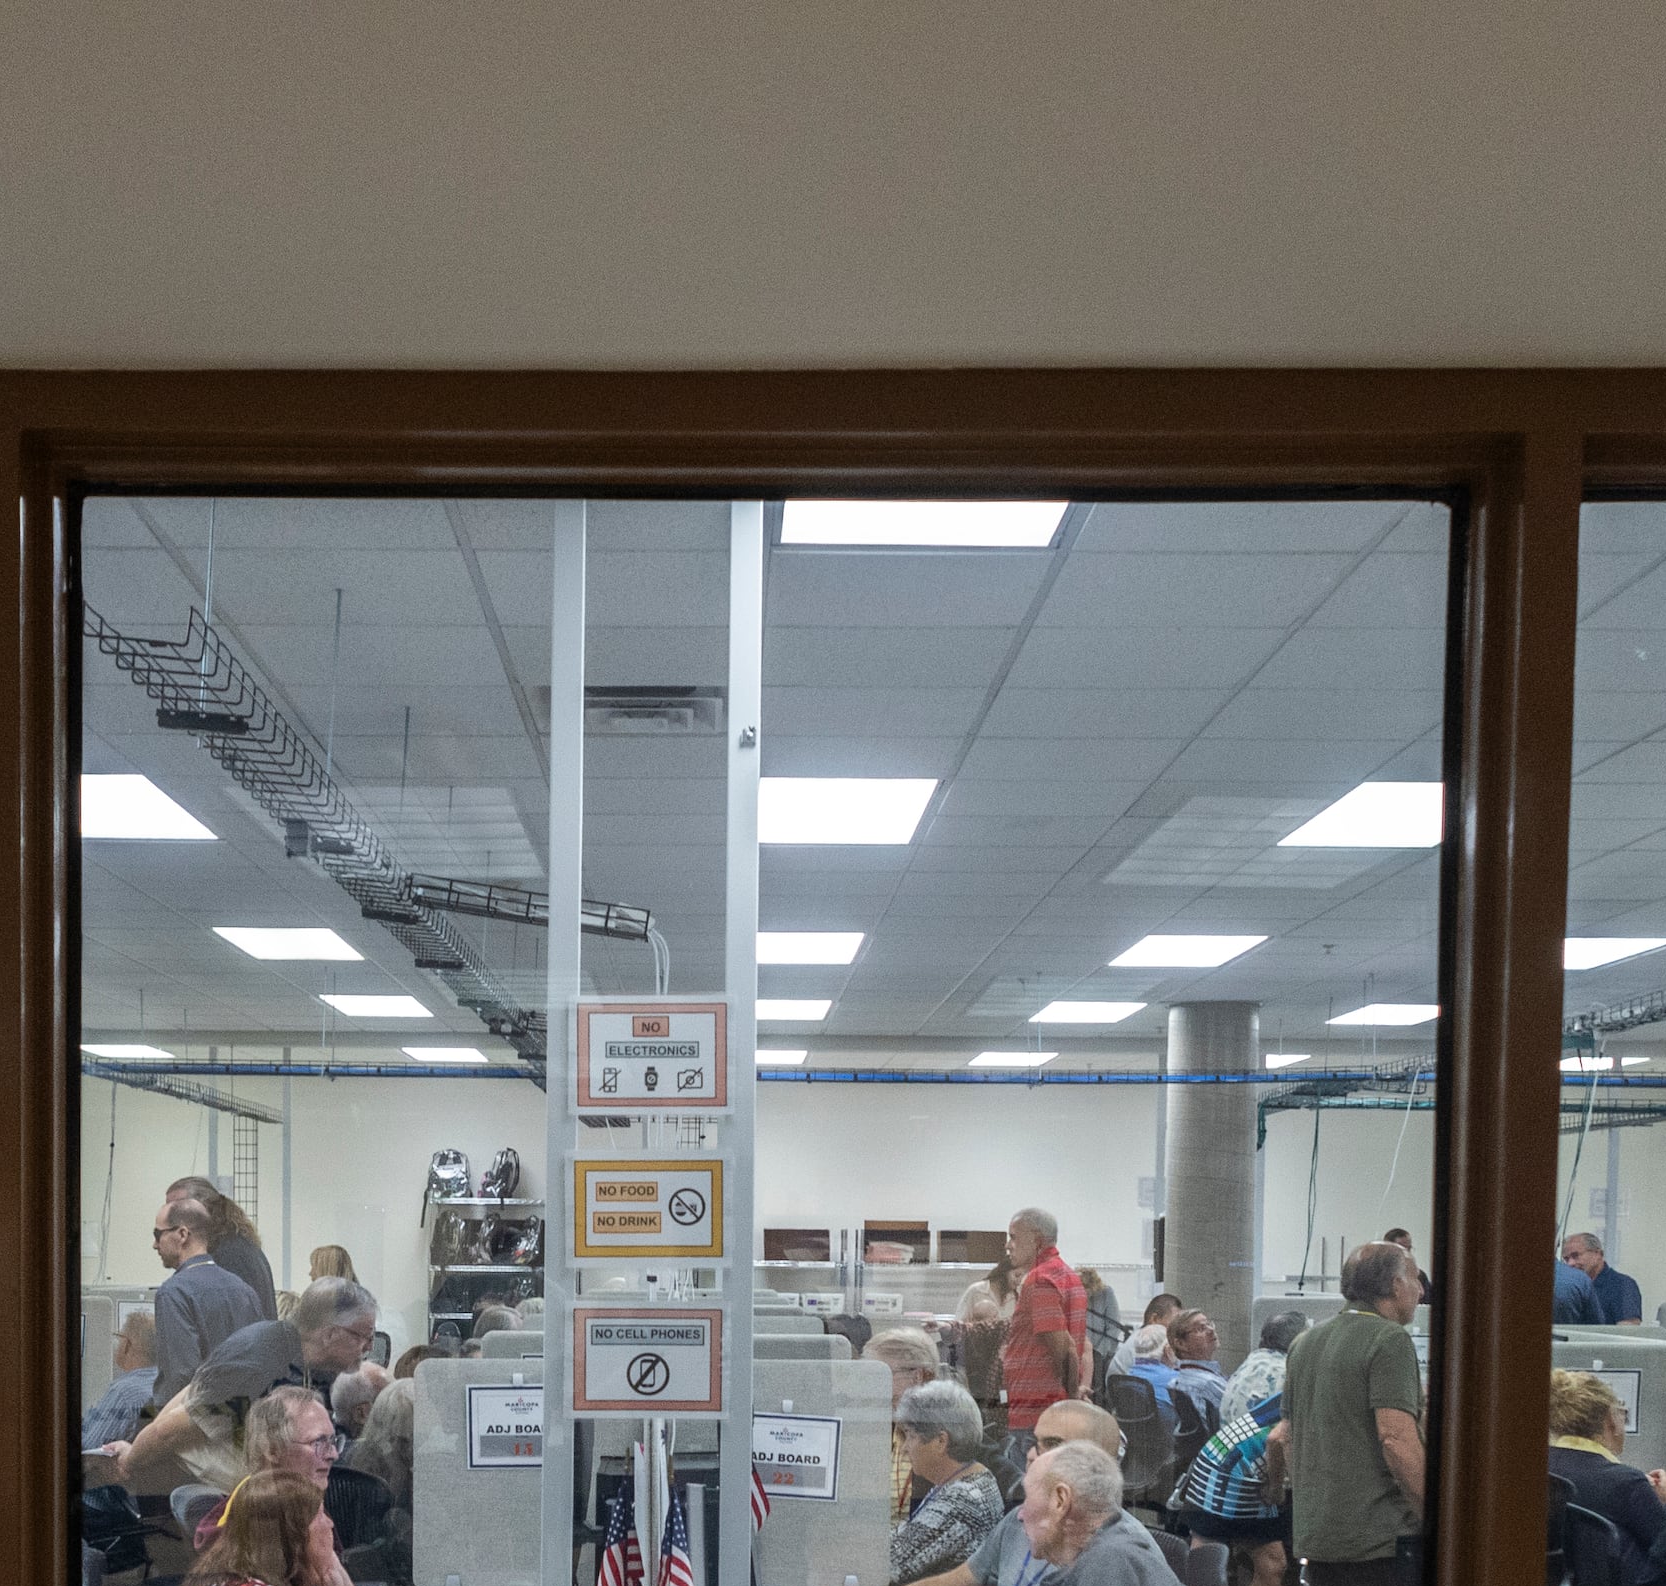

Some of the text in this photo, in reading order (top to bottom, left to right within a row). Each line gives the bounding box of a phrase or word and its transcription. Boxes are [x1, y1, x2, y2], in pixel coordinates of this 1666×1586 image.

[641, 1022, 661, 1033] NO
[608, 1045, 696, 1056] ELECTRONICS
[598, 1186, 655, 1196] NO FOOD
[596, 1216, 657, 1226] NO DRINK
[595, 1329, 701, 1340] NO CELL PHONES
[486, 1425, 543, 1433] ADJ BOA
[778, 1453, 821, 1464] BOARD
